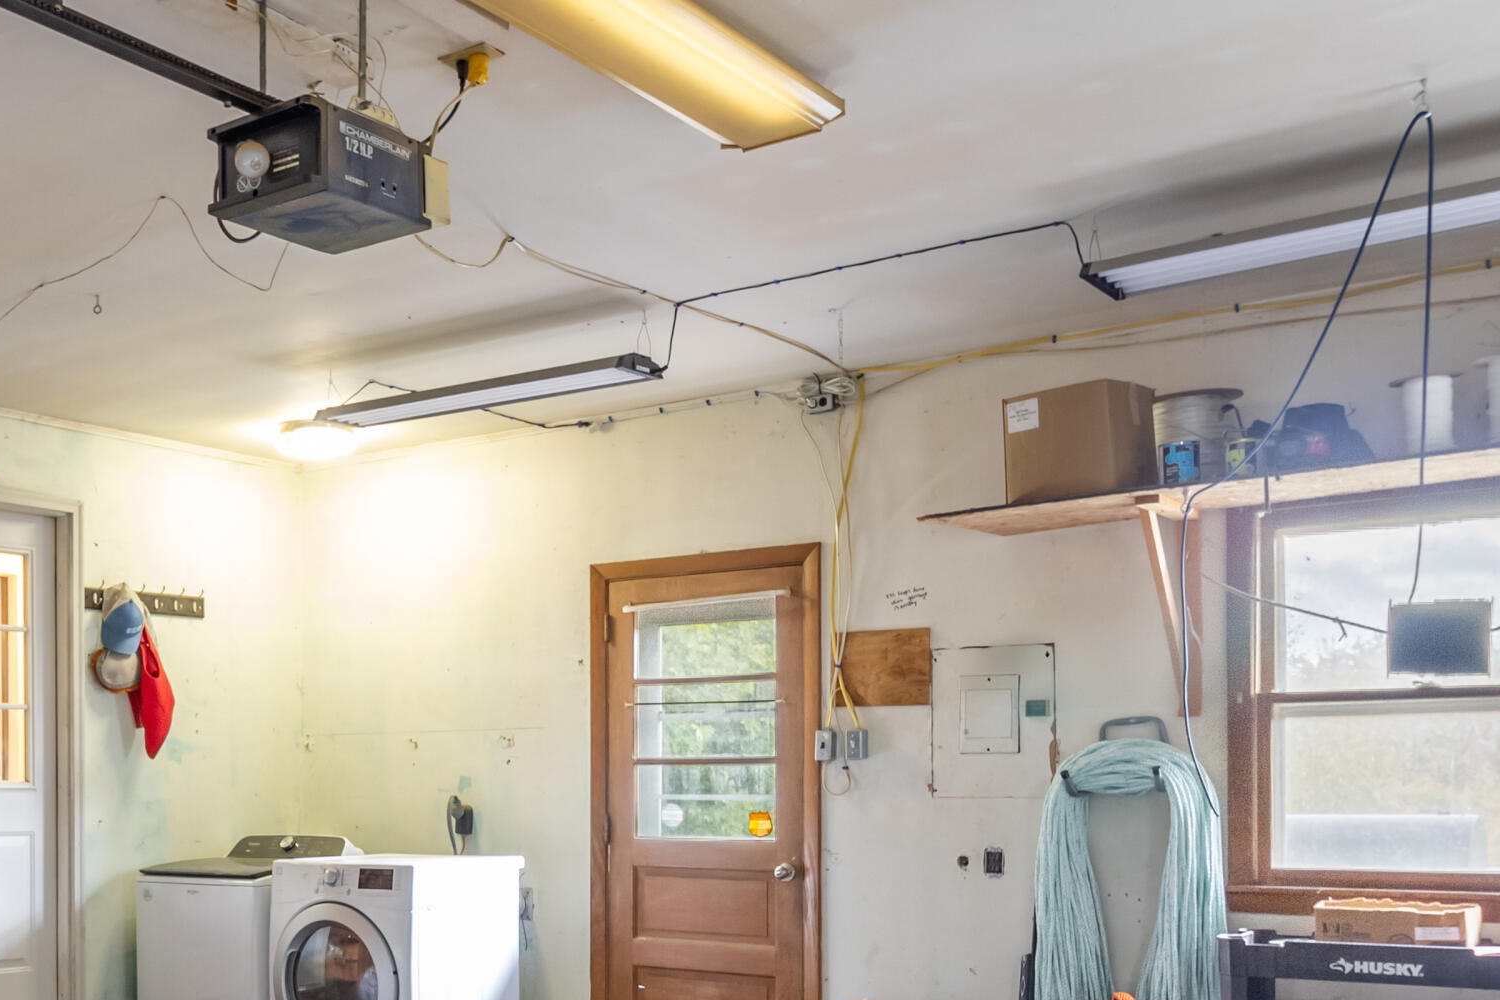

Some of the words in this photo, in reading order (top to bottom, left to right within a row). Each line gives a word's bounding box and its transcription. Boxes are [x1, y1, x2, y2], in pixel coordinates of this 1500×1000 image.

[345, 136, 360, 154] 1/2
[346, 126, 410, 160] CHAMBERLAIN
[1353, 960, 1424, 977] HUSKY
